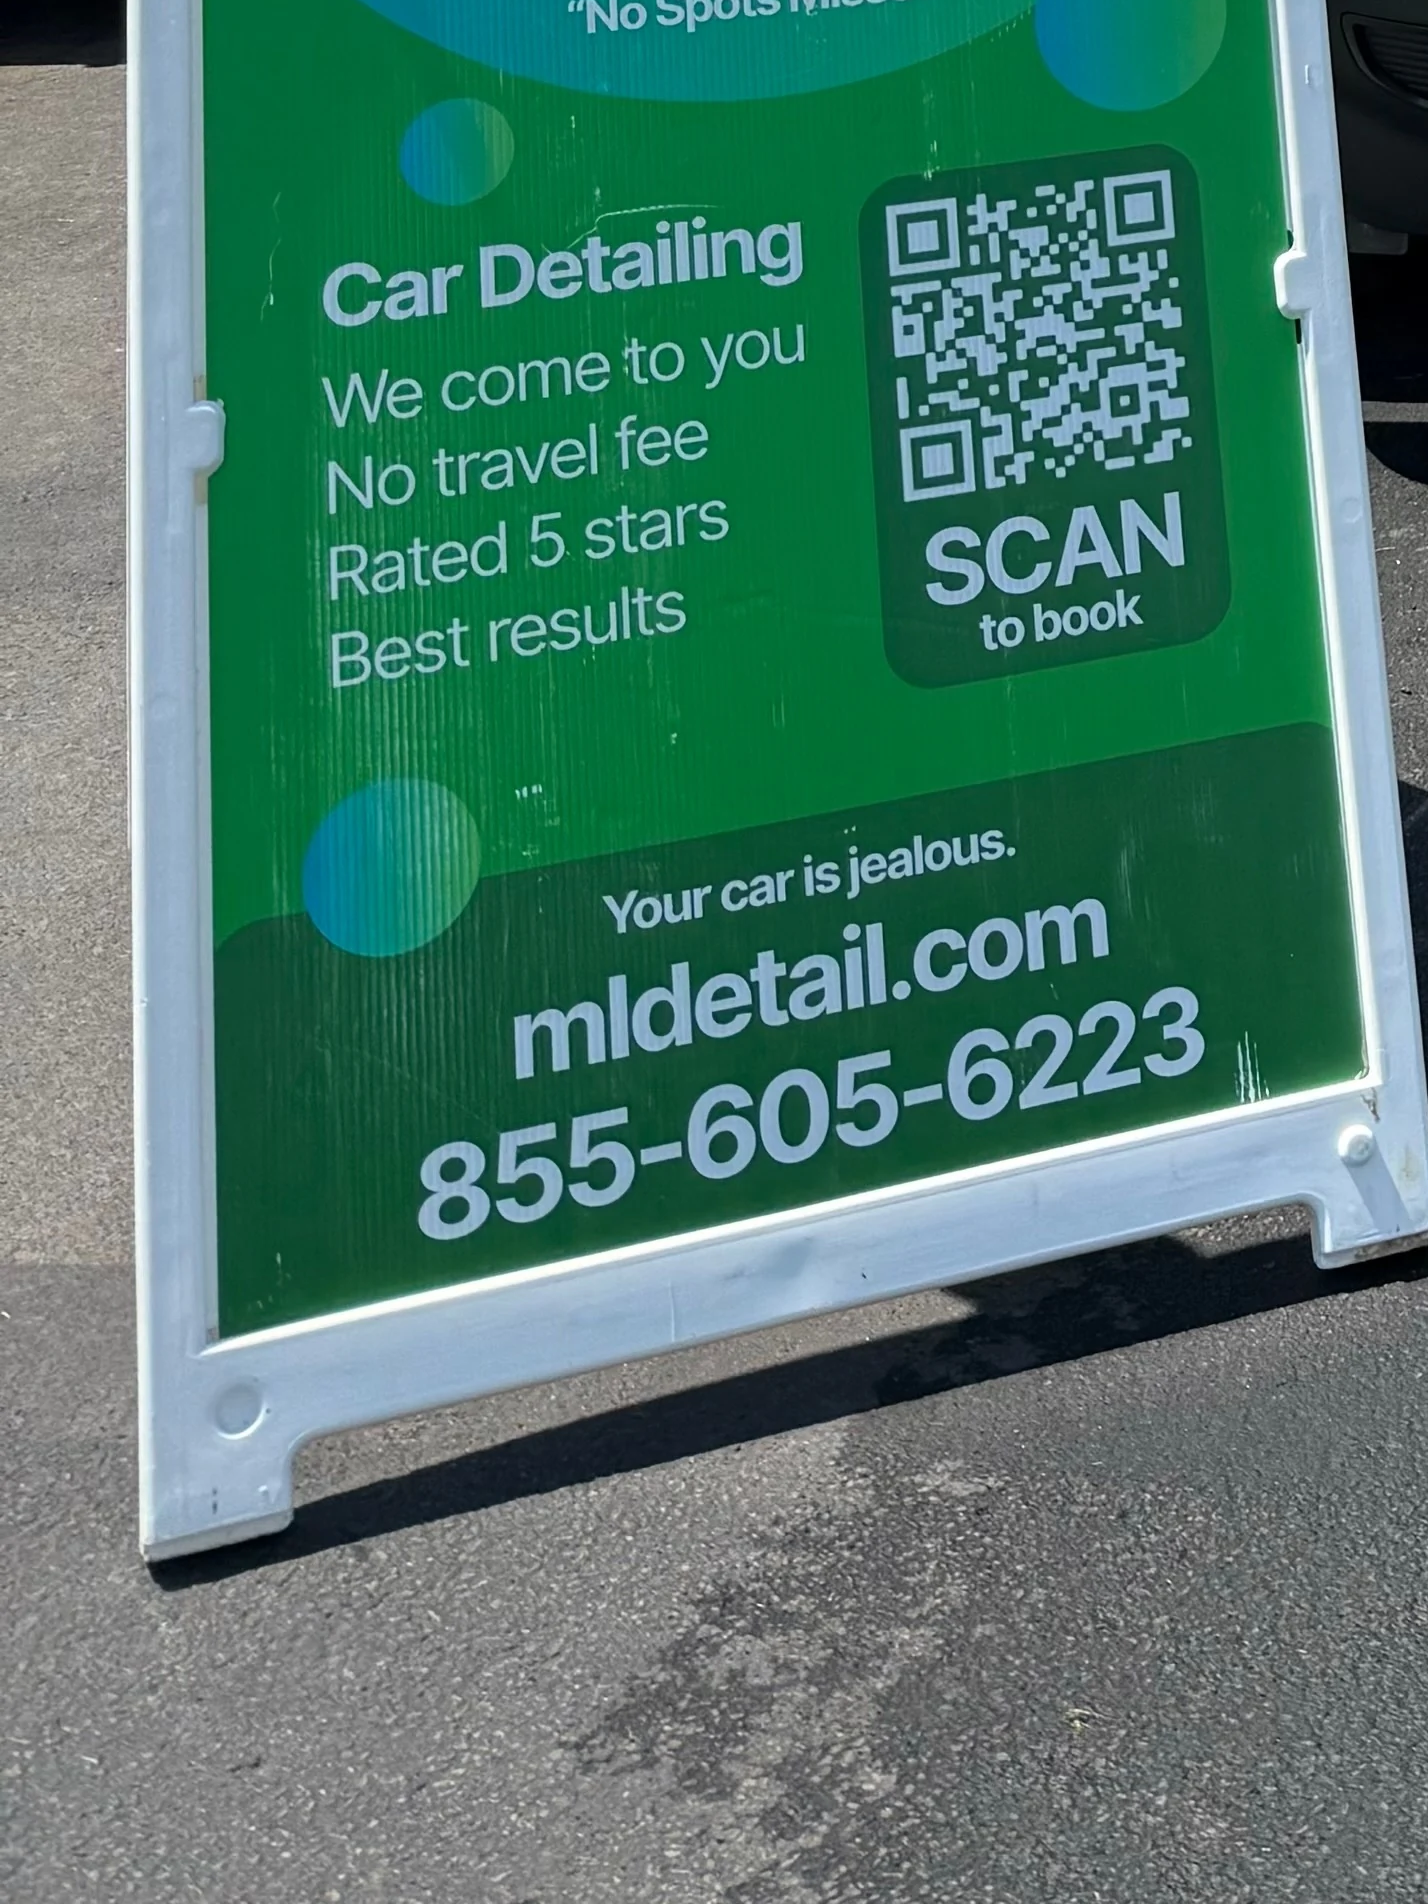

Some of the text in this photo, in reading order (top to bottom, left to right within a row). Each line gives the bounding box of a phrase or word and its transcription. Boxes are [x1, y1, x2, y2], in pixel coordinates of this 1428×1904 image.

[322, 216, 803, 327] Car Detailing
[321, 324, 805, 428] We come to you
[328, 415, 709, 515] No travel fee
[329, 500, 729, 601] Rated 5 stars
[925, 491, 1185, 606] SCAN
[331, 586, 686, 688] Best results
[978, 588, 1144, 651] to book
[602, 829, 1016, 934] Your car is jealous.
[513, 895, 1110, 1080] mldetail.com
[417, 985, 1206, 1241] 855-605-6223
